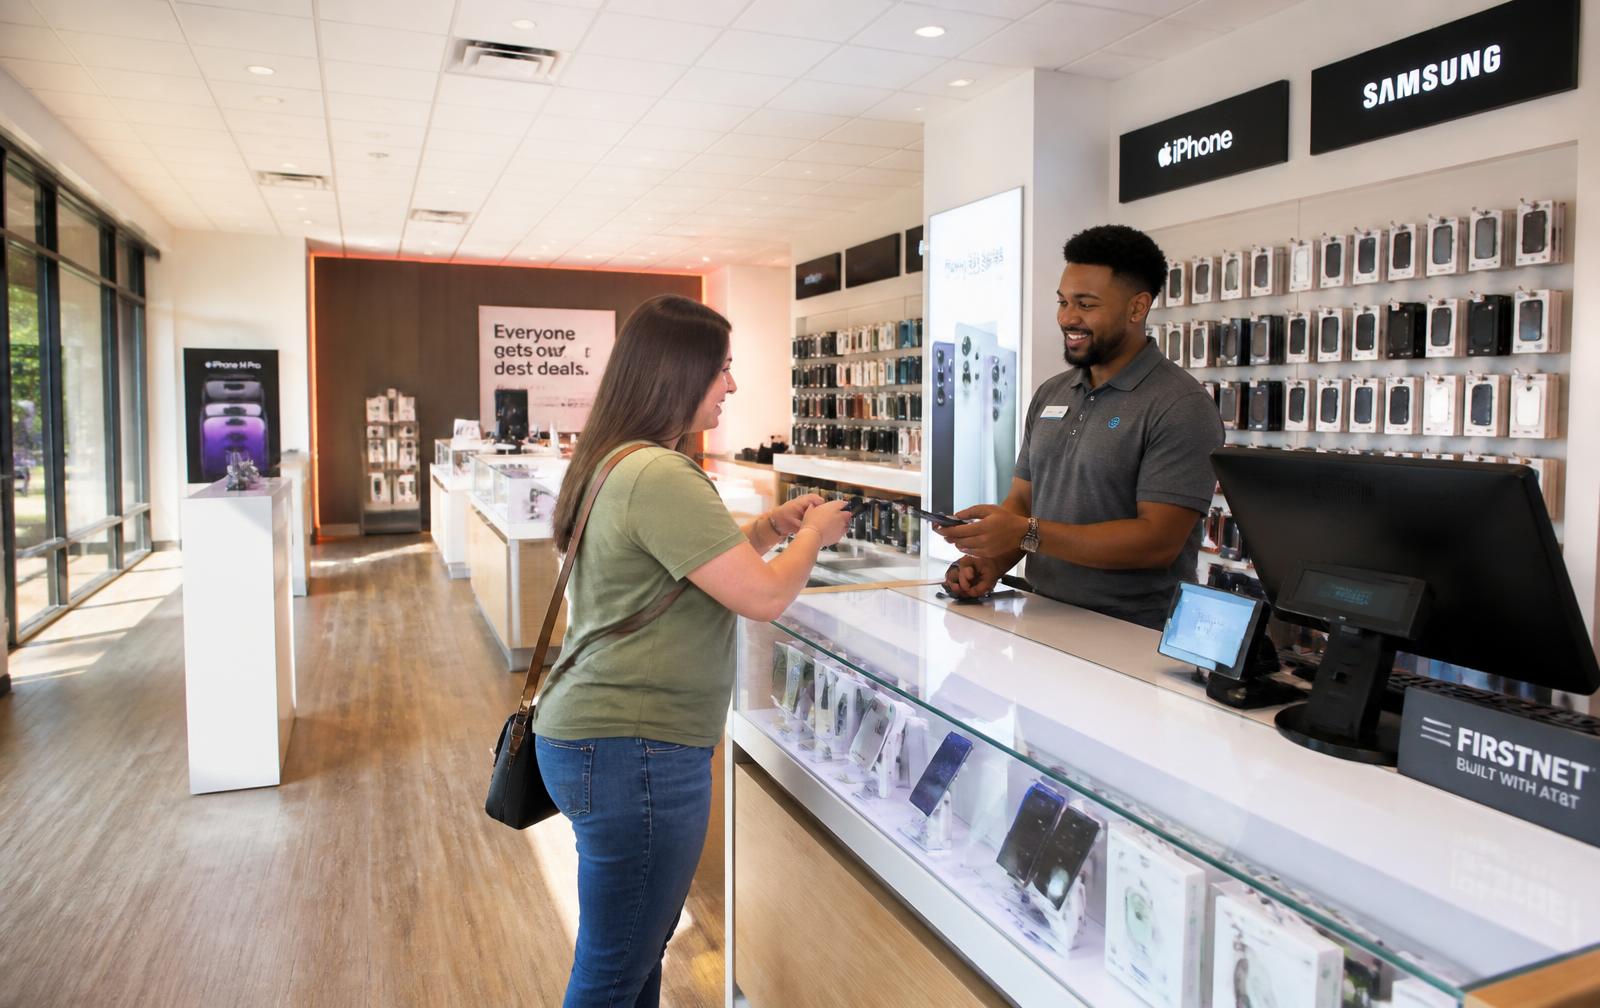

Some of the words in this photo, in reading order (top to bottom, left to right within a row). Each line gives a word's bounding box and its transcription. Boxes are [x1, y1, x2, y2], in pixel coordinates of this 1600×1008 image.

[1363, 44, 1501, 109] SAMSUNG
[1172, 129, 1233, 164] iPhone
[494, 323, 576, 343] Everyone
[247, 361, 262, 369] Pro
[494, 344, 533, 359] gets
[537, 361, 589, 376] deals.
[1457, 727, 1590, 790] FIRSTNET
[1499, 771, 1537, 796] WITH
[1539, 786, 1581, 809] AT&T
